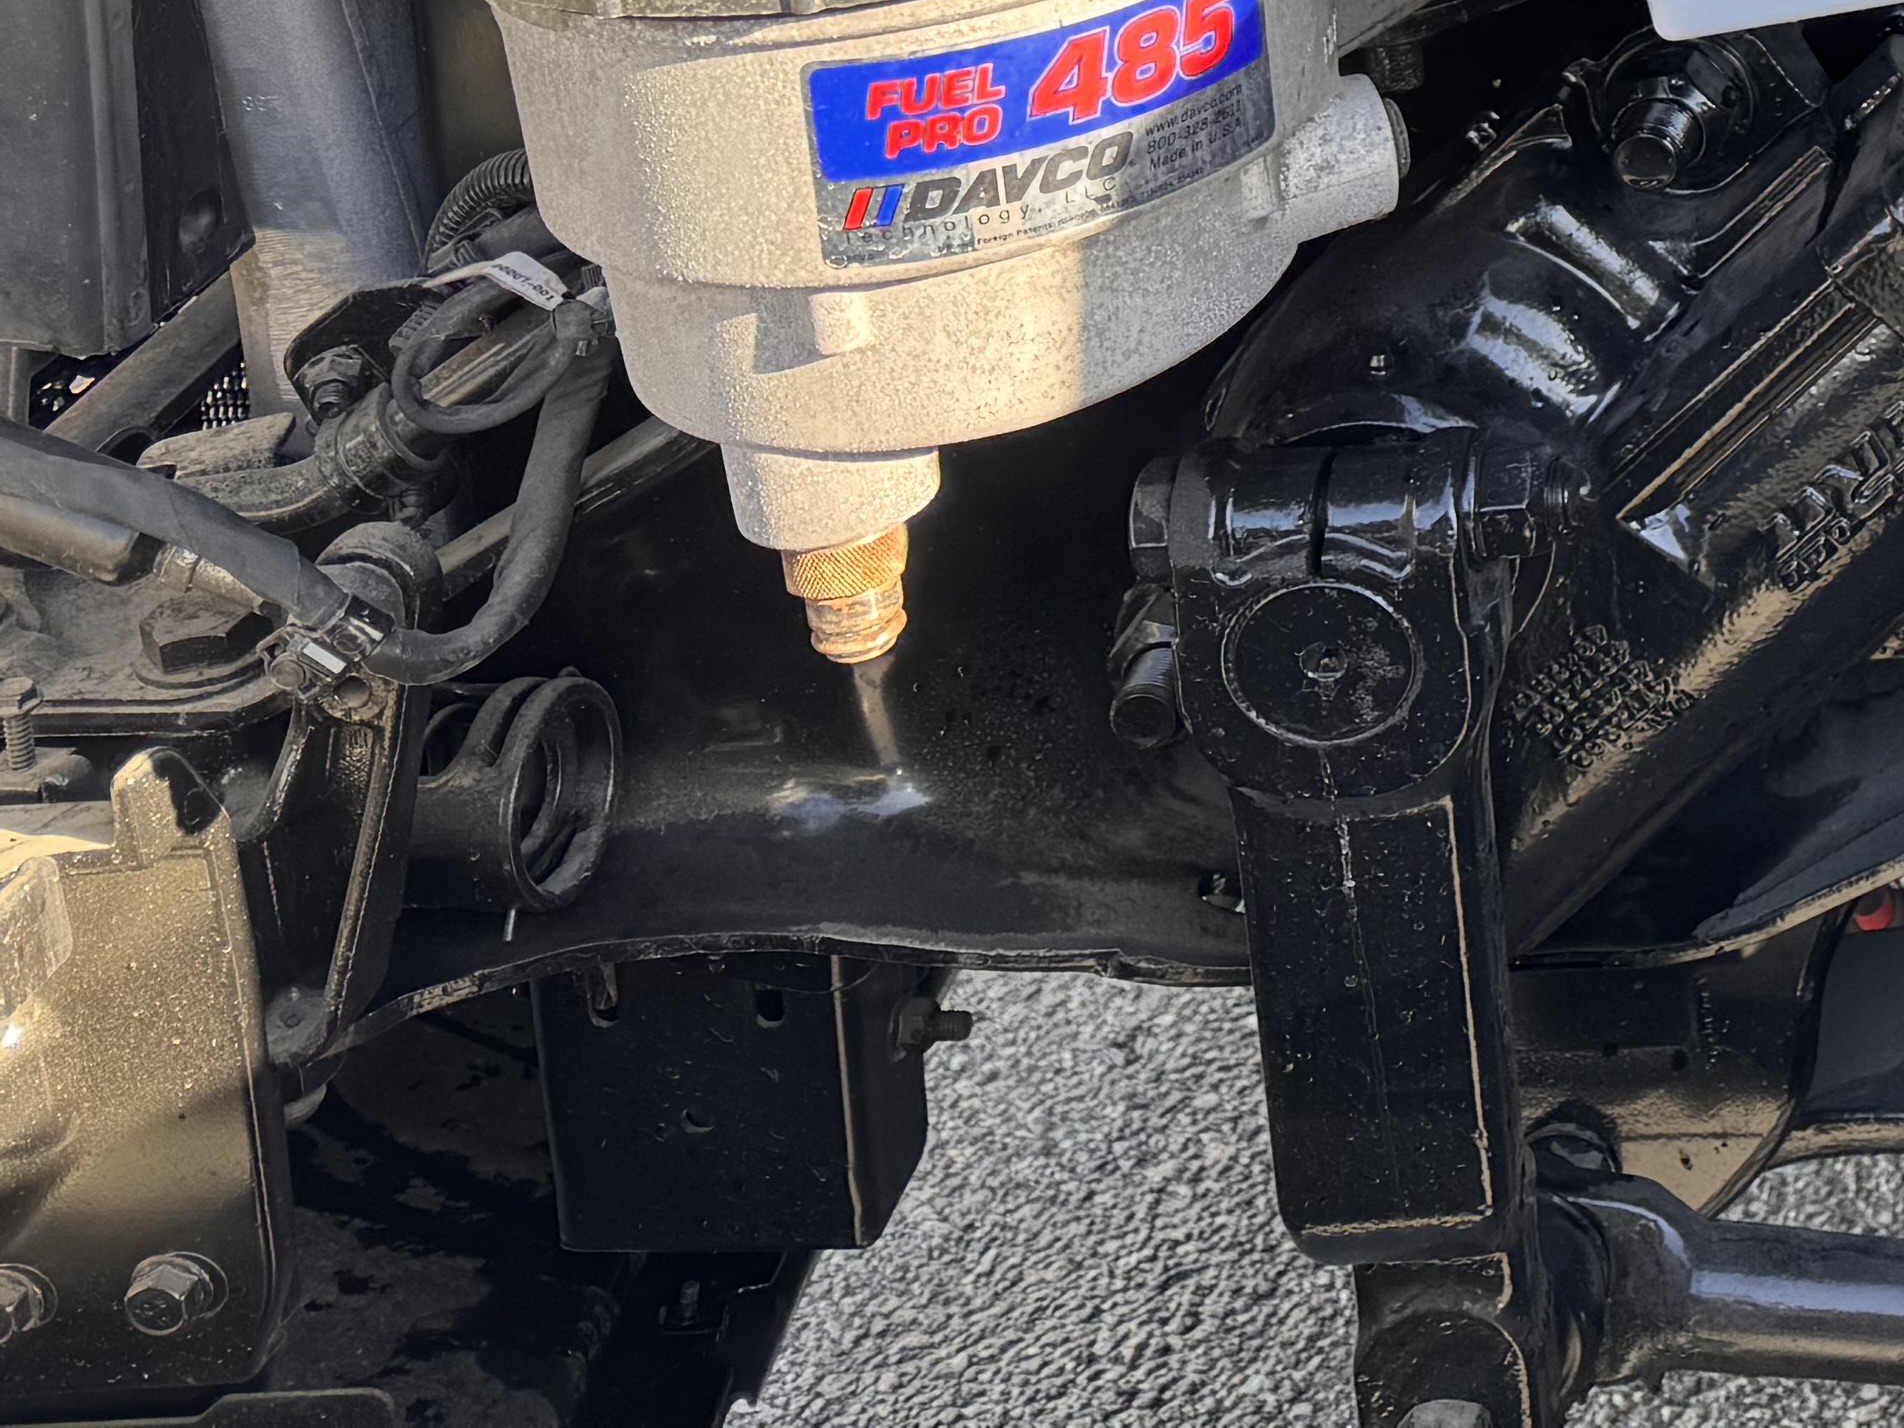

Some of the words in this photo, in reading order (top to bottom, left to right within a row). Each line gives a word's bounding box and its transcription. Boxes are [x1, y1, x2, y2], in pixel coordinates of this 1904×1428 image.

[864, 61, 1007, 122] FUEL
[1144, 83, 1243, 138] www.davco.com
[883, 103, 1004, 160] PRO
[1149, 146, 1188, 172] Made
[1191, 138, 1204, 152] in
[904, 130, 1135, 223] DAVCO
[1065, 176, 1117, 206] LLC
